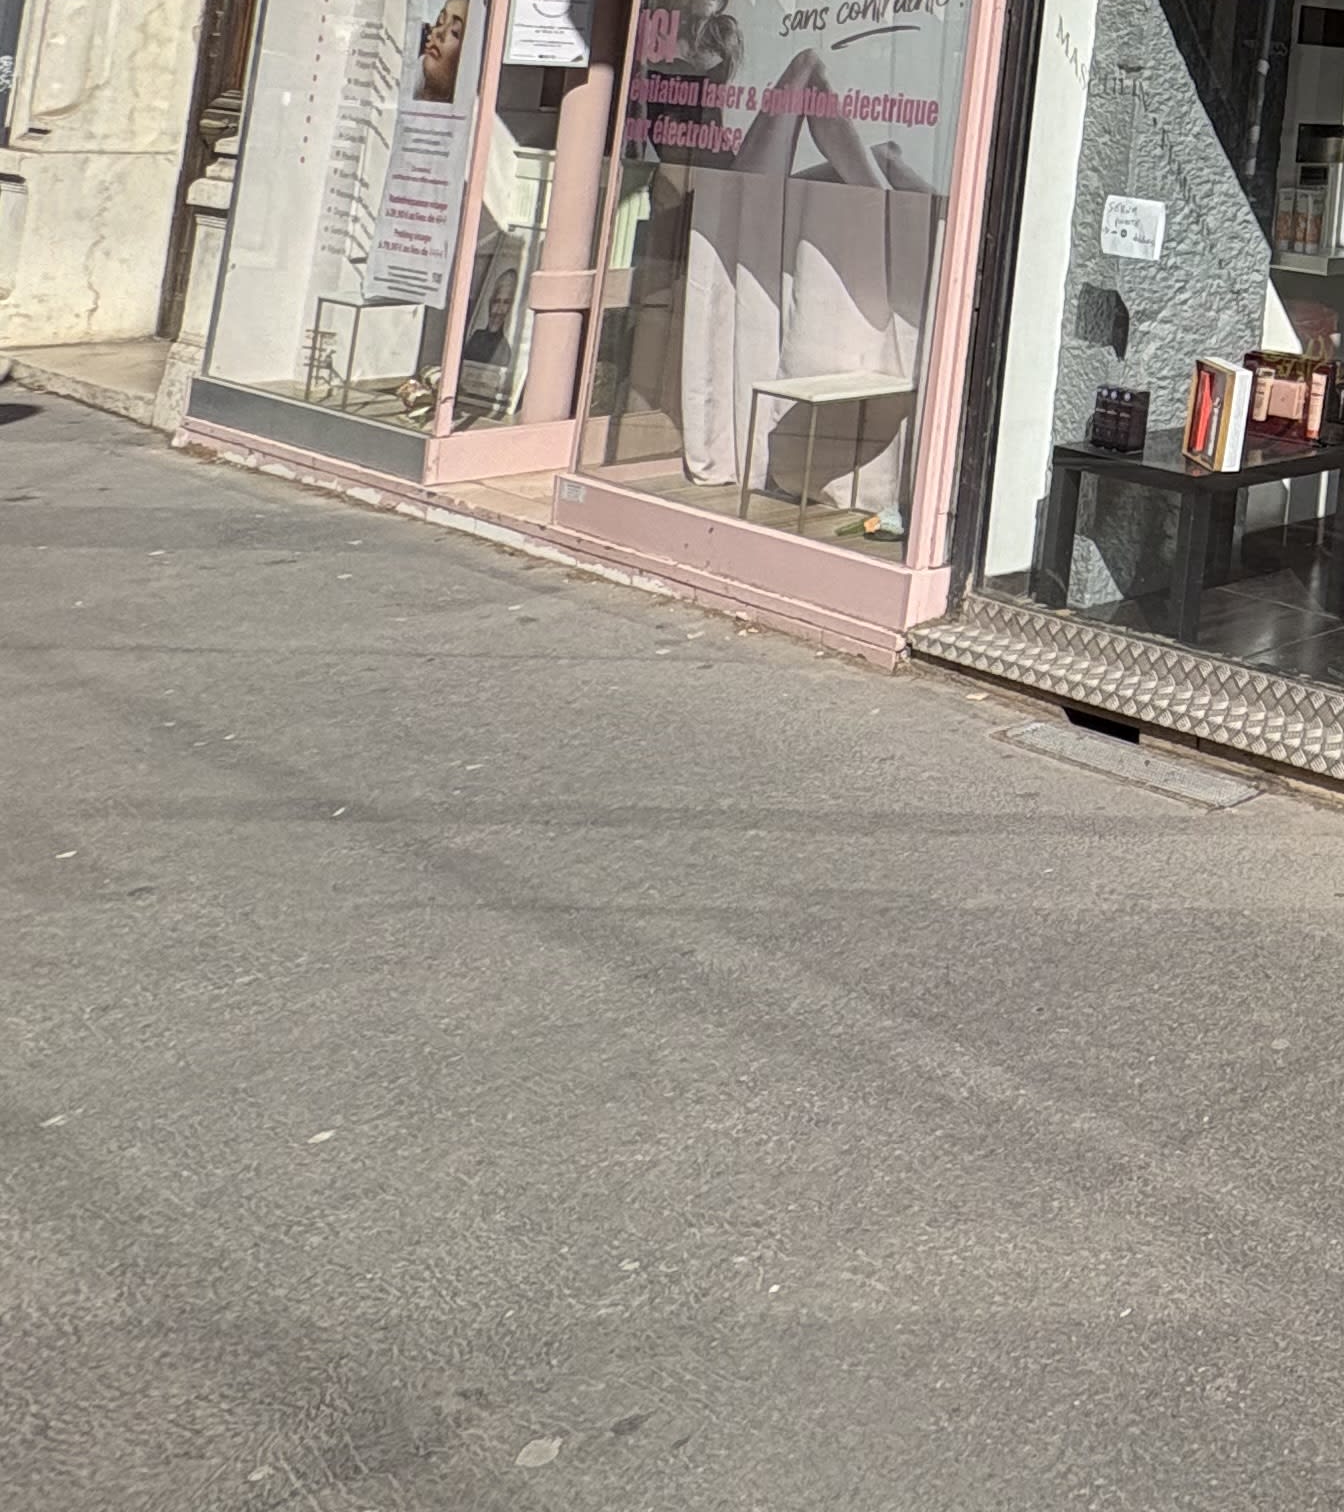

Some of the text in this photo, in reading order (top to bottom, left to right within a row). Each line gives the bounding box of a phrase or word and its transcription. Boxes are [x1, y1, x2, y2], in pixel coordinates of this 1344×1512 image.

[779, 7, 829, 37] sans
[701, 78, 745, 110] laser
[745, 85, 757, 111] &
[842, 88, 939, 128] électrique
[652, 112, 744, 153] électrolyse
